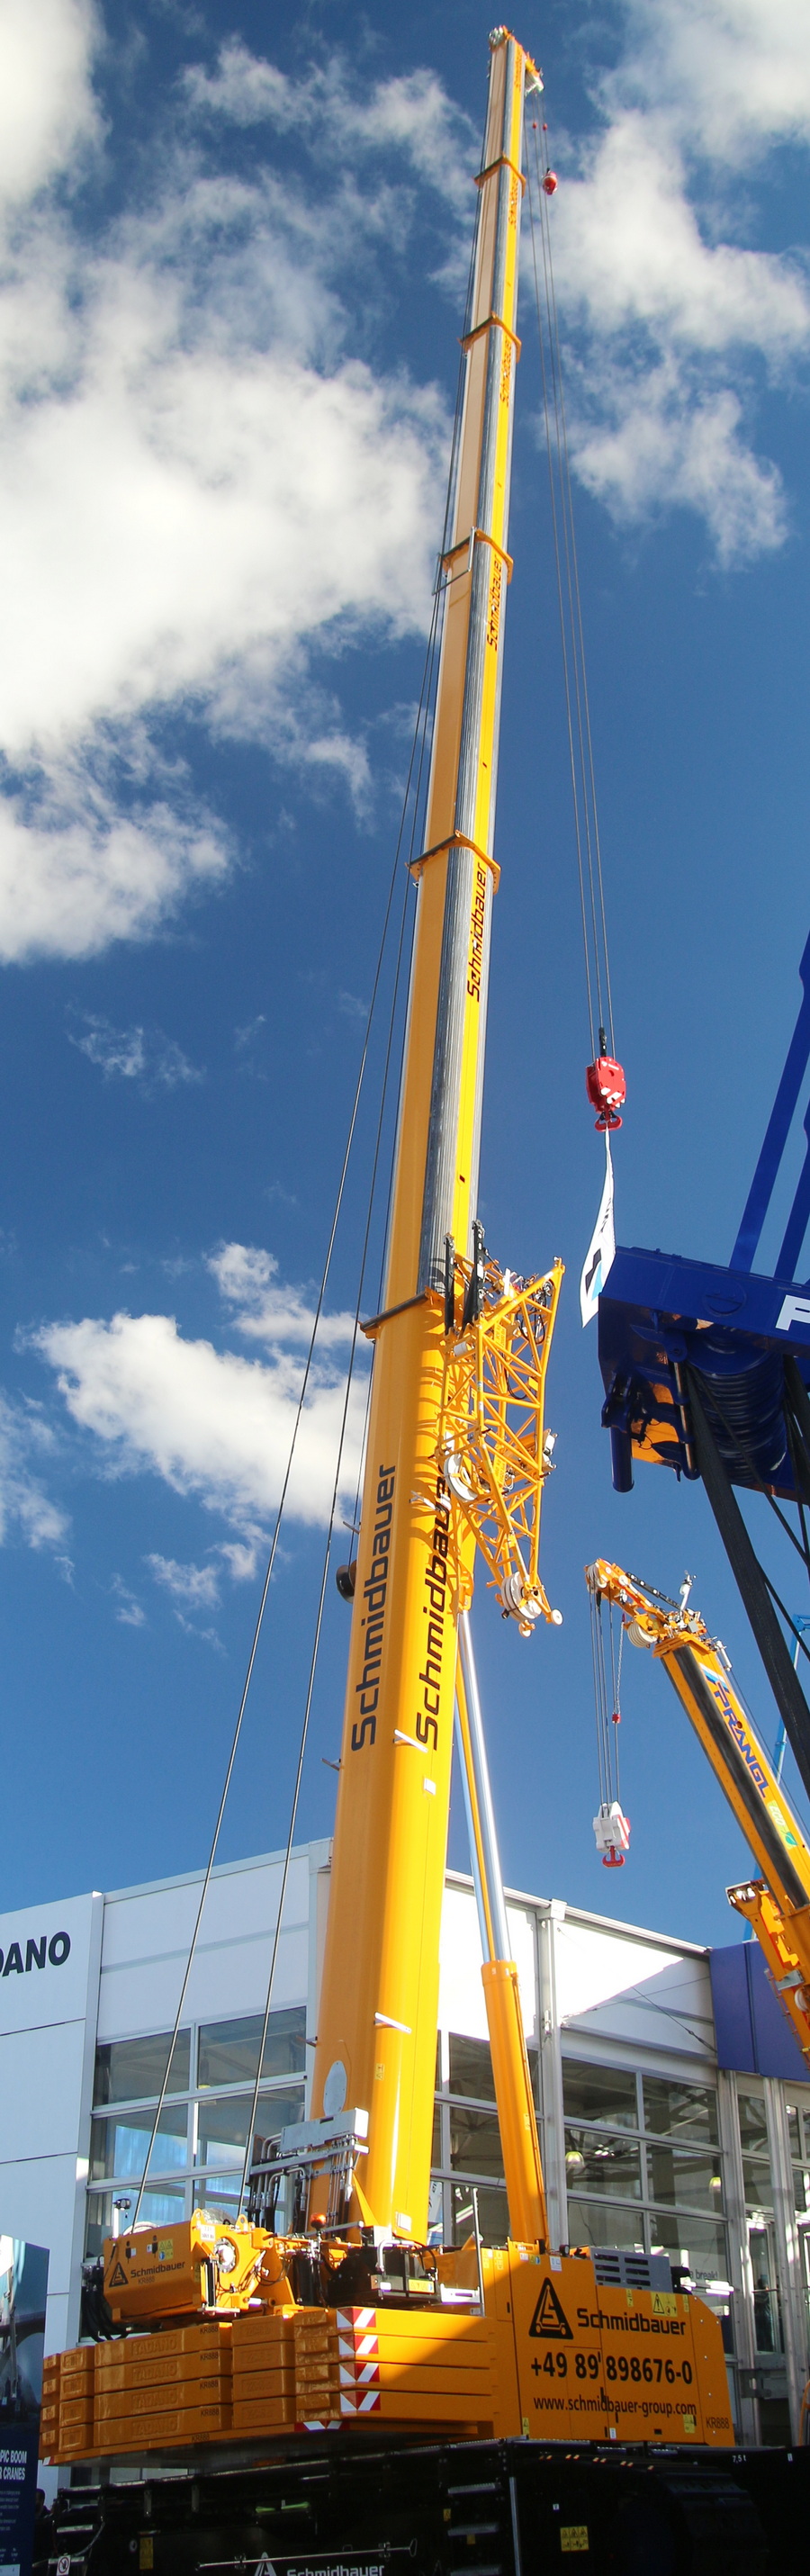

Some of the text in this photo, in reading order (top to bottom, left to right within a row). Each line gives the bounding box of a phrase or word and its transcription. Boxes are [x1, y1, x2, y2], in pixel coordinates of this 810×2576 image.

[487, 554, 502, 651] Schmidbauer
[467, 861, 487, 1003] Schmidbauer
[351, 1464, 396, 1752] Schmidbauer
[416, 1465, 451, 1752] Schmidbaue
[715, 1680, 769, 1798] PRANGL
[769, 1805, 787, 1827] ECO
[0, 1931, 71, 1977] ANO
[130, 2262, 185, 2278] Schmidbauer
[577, 2308, 686, 2336] Schmidbauer
[531, 2352, 693, 2385] +49 89 898676-0
[533, 2394, 697, 2418] www.schmidbauer-group.com
[706, 2417, 730, 2429] KR888
[10, 2450, 27, 2463] BOOM
[4, 2466, 26, 2481] CRANES
